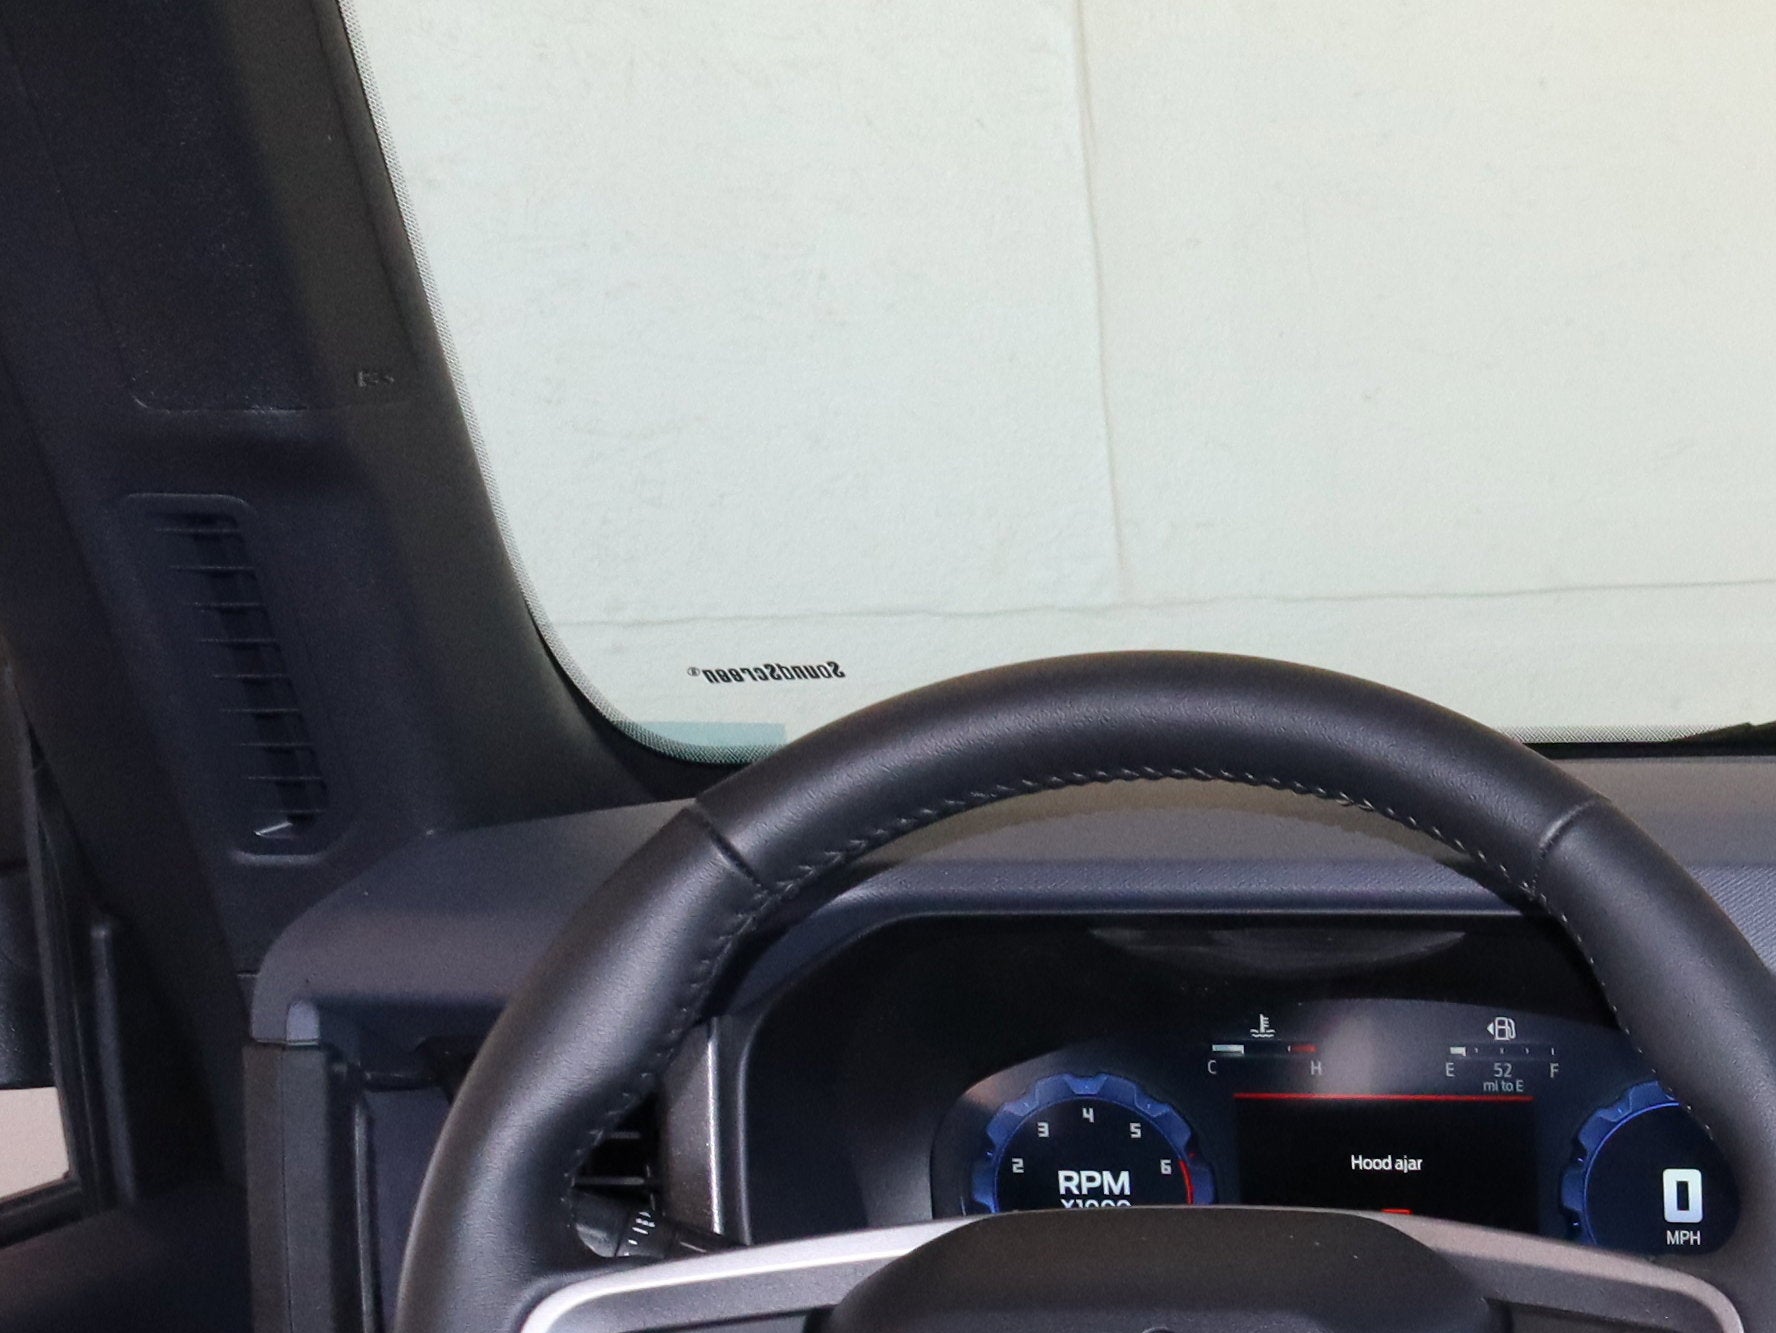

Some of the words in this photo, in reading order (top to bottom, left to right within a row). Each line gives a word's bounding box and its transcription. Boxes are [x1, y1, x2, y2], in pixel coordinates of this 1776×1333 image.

[1207, 1060, 1217, 1075] C
[1310, 1060, 1322, 1075] H
[1446, 1062, 1454, 1077] E
[1493, 1063, 1513, 1078] 52
[1550, 1063, 1559, 1078] F
[1483, 1080, 1499, 1092] mi
[1501, 1081, 1514, 1092] to
[1516, 1080, 1525, 1092] E
[1082, 1107, 1095, 1123] 4
[1037, 1122, 1050, 1138] 3
[1129, 1122, 1142, 1138] 5
[1011, 1158, 1024, 1174] 2
[1160, 1159, 1172, 1175] 6
[1351, 1154, 1392, 1171] Hood
[1395, 1155, 1423, 1173] ajar
[1057, 1170, 1131, 1196] RPM
[1663, 1168, 1703, 1223] 0
[1666, 1230, 1701, 1246] MPH
